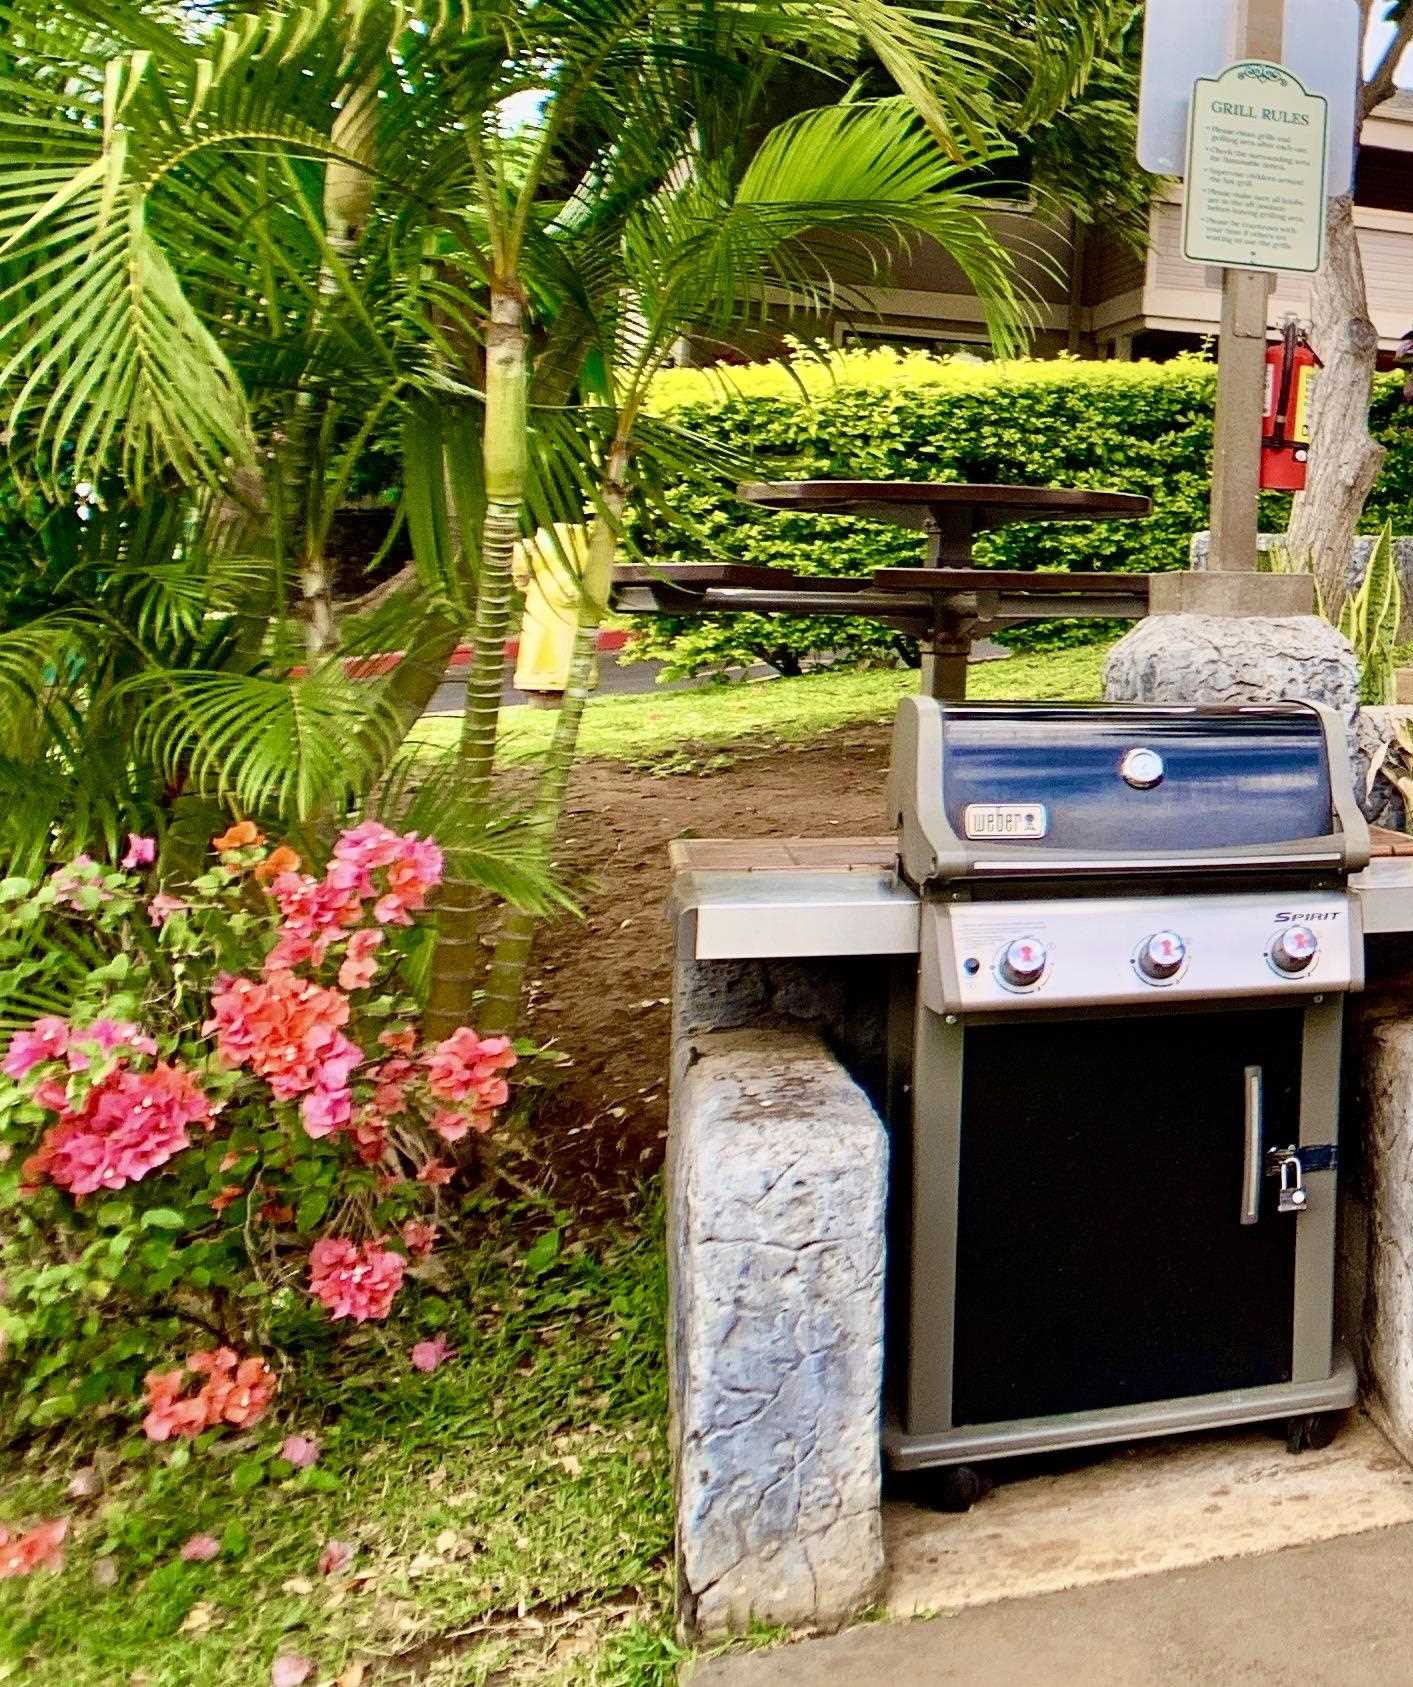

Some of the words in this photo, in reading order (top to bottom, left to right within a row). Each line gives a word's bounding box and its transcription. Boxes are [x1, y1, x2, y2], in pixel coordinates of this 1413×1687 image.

[1211, 101, 1256, 118] GRILL
[1262, 108, 1310, 126] RULES
[972, 807, 1021, 832] weber
[1274, 911, 1341, 923] SPIRIT
